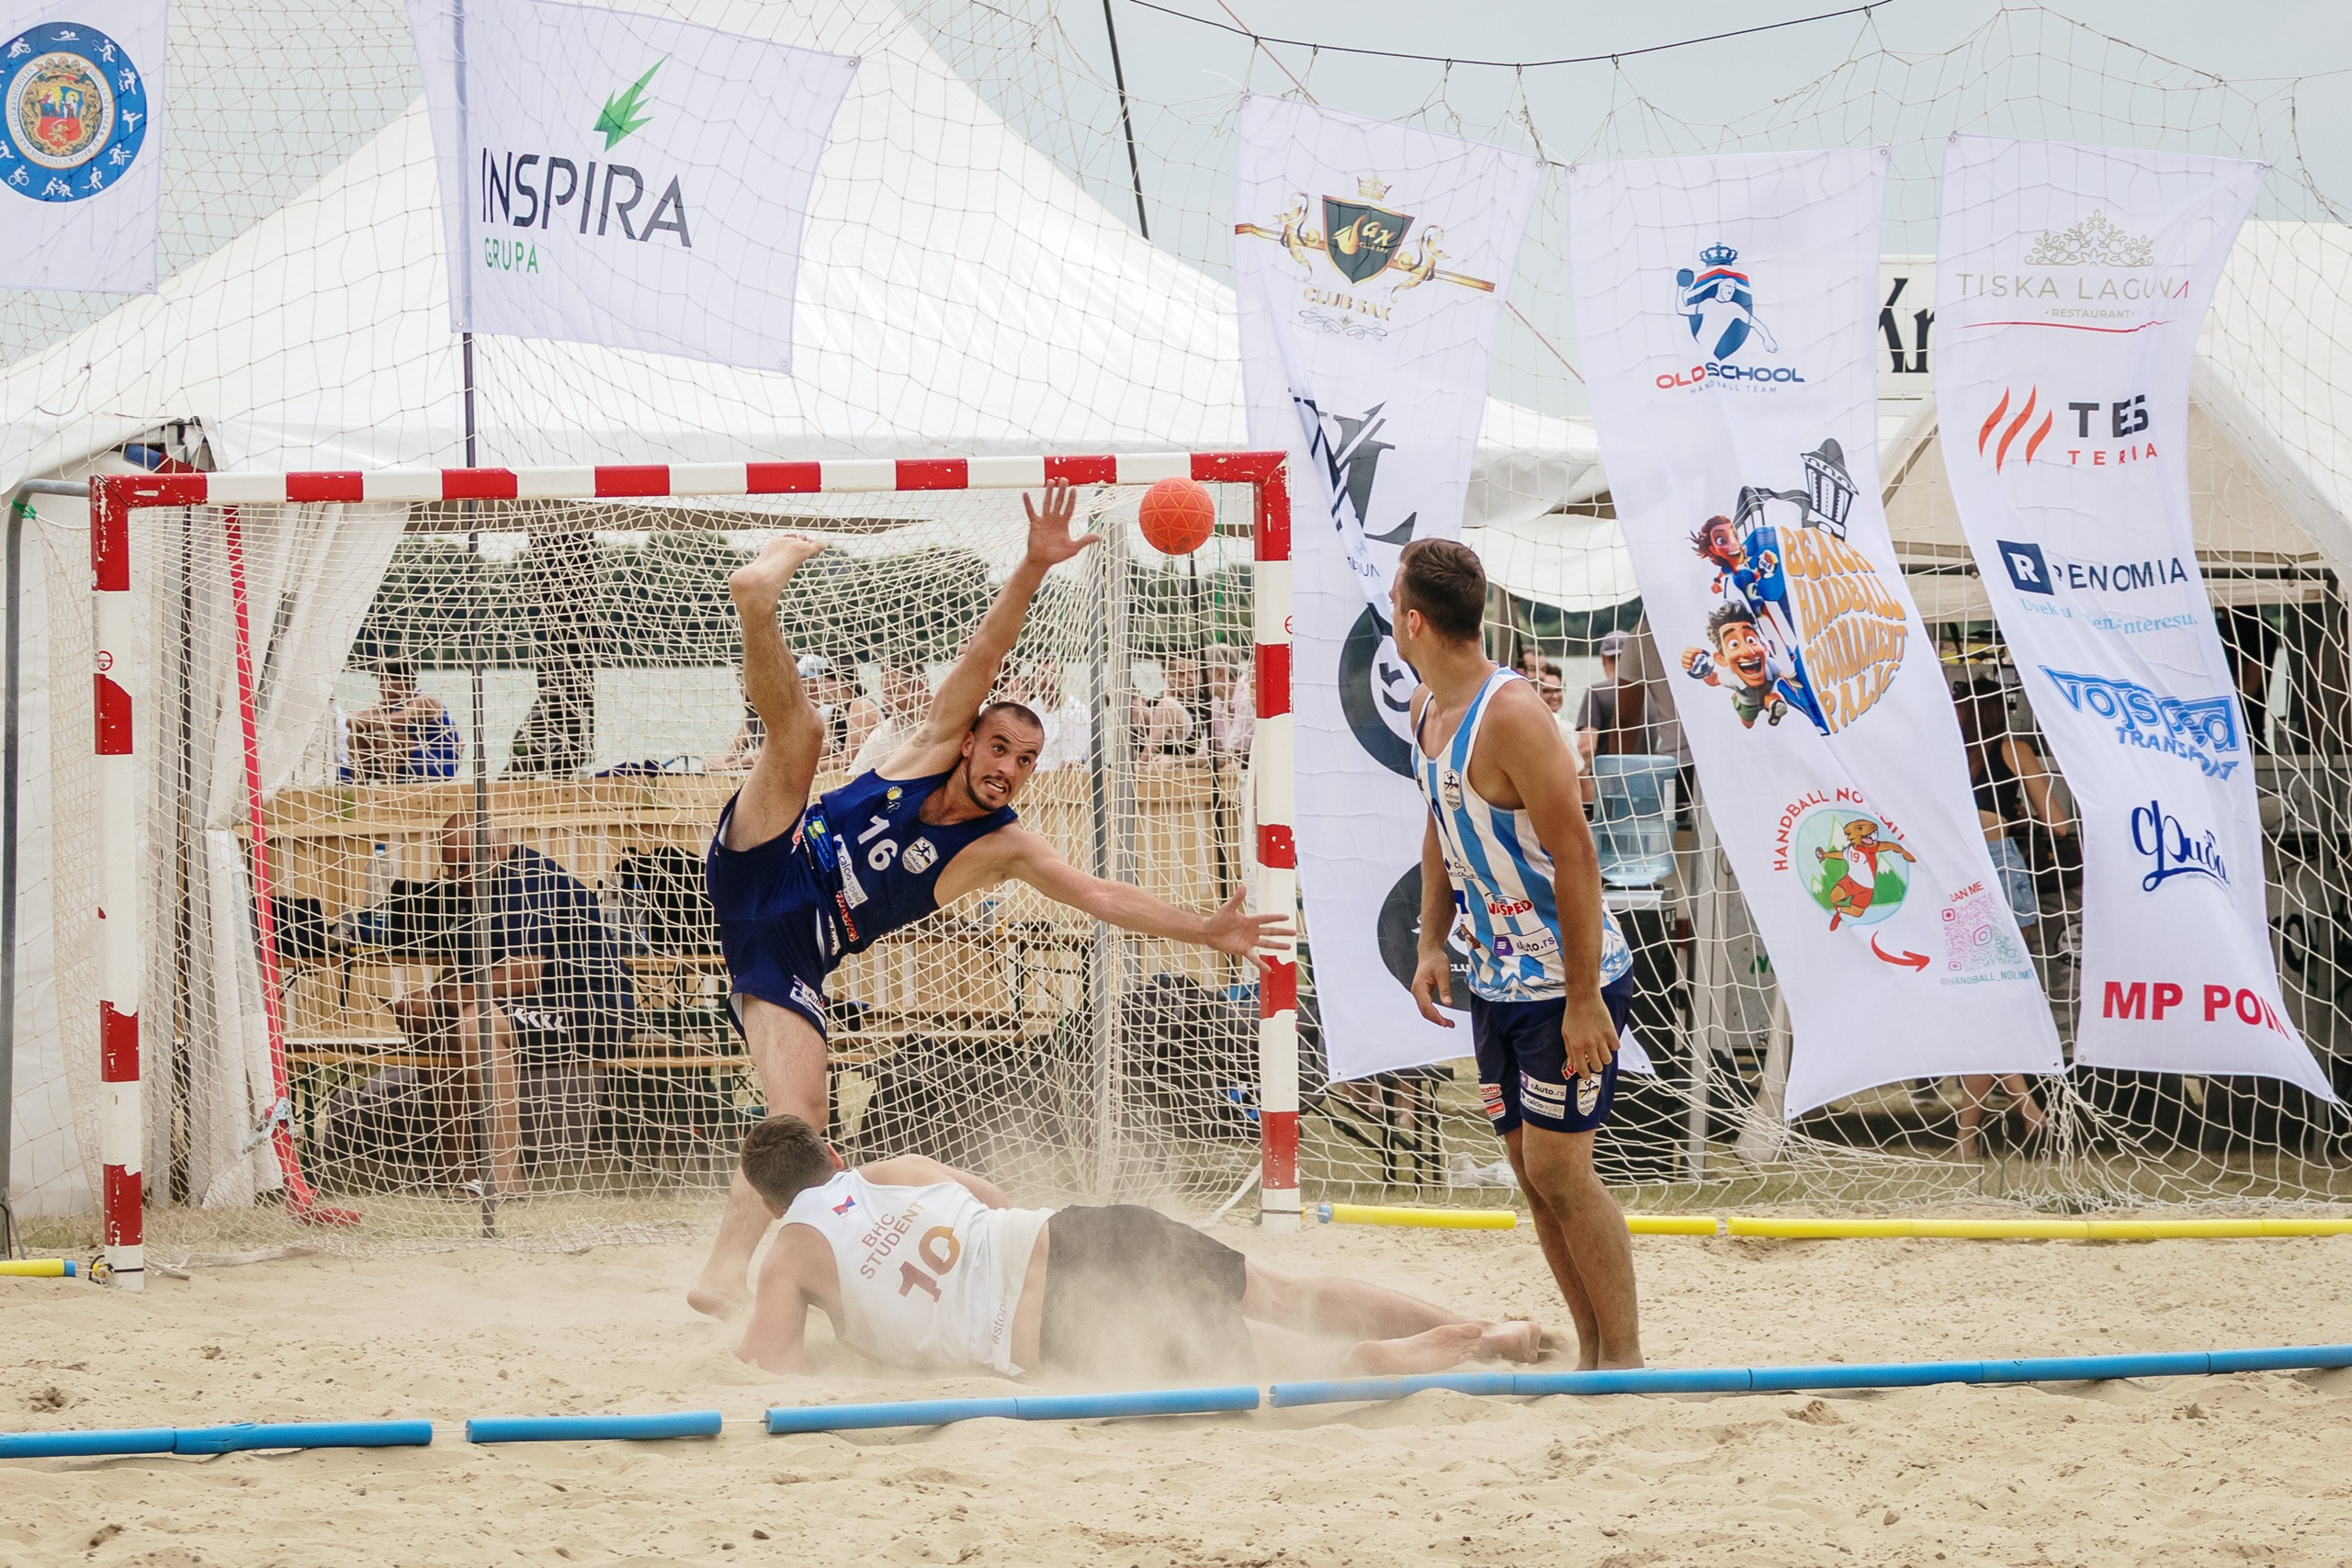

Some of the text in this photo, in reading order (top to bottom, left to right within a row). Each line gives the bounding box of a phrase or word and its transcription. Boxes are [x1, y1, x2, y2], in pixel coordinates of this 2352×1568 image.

[482, 147, 692, 248] INSPIRA
[485, 237, 539, 274] GRUPA
[1304, 287, 1392, 321] CLUB SAX
[1956, 274, 2059, 299] TISKA
[2052, 309, 2132, 319] RESTAURANT
[1747, 385, 1778, 394] TEAM
[2067, 443, 2158, 466] TERIA
[1781, 526, 1875, 581] BEACH
[1792, 574, 1906, 644] HANDBALL
[1804, 616, 1908, 694] TOURNAMENT
[858, 815, 898, 871] 16
[1773, 790, 1829, 872] HANDBALL
[1837, 787, 1864, 804] NO
[838, 854, 853, 881] calcio
[1968, 881, 1984, 895] ME
[2102, 981, 2183, 1021] MP
[1531, 1084, 1565, 1097] eAuto.rs
[860, 1201, 925, 1280] STUDENT
[862, 1213, 896, 1248] BHC
[898, 1225, 961, 1303] 10
